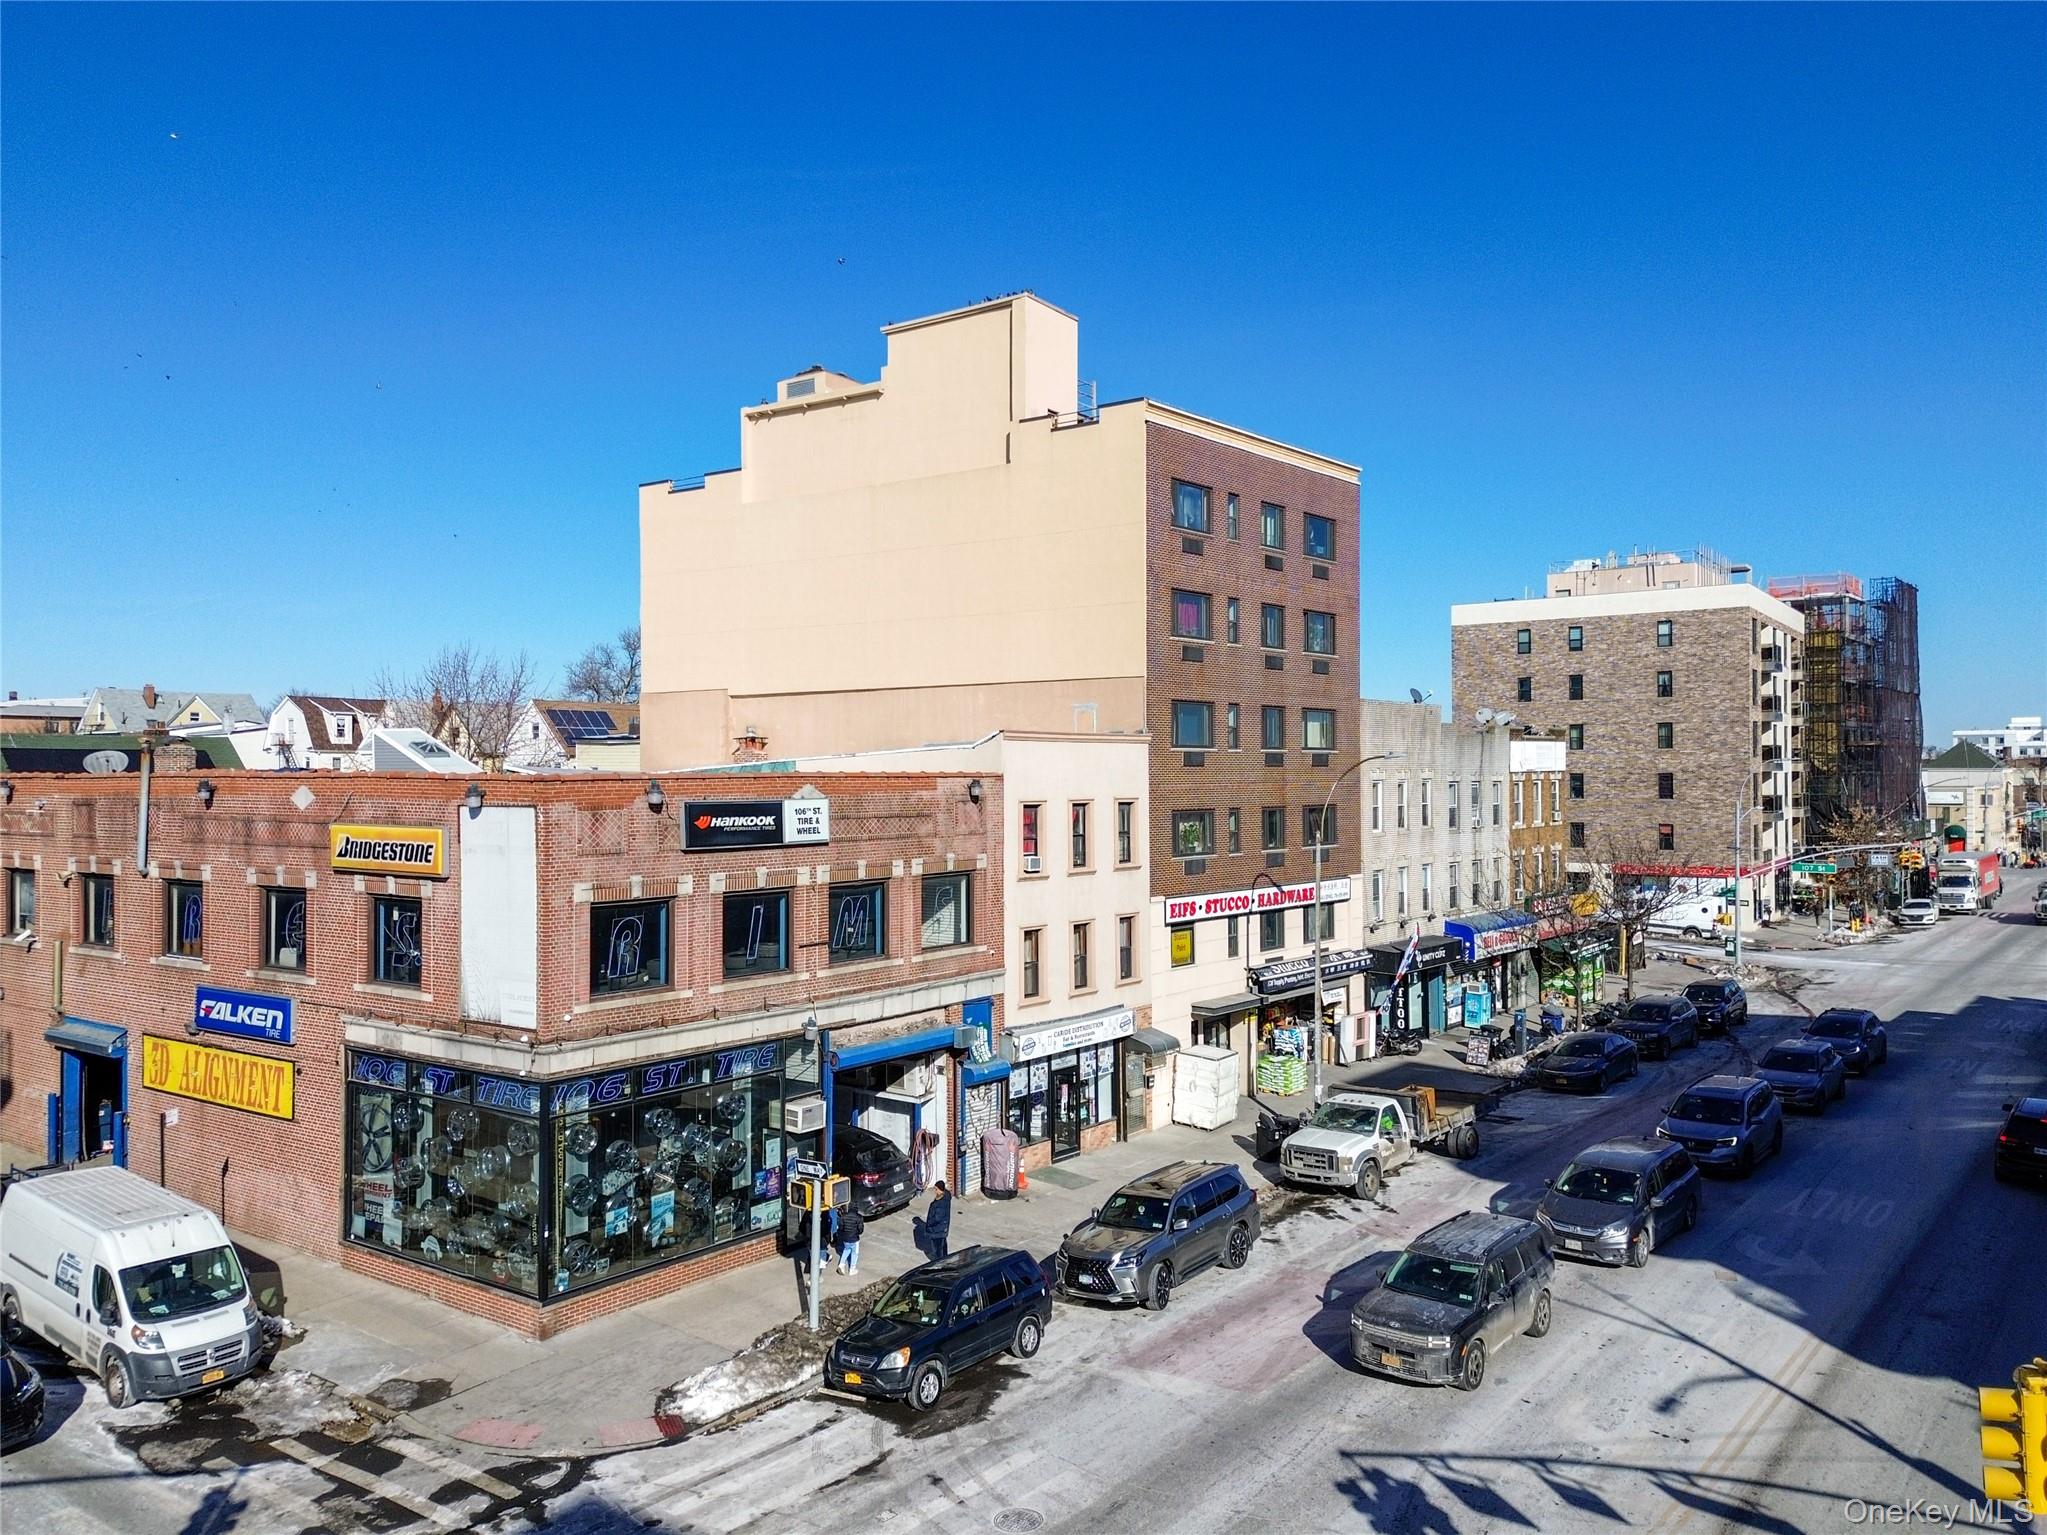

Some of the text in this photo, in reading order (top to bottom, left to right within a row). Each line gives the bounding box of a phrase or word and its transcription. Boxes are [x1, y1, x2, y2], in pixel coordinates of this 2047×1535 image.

[812, 807, 823, 815] ST.
[796, 826, 821, 835] WHEEL
[797, 817, 813, 825] TIRE
[336, 836, 434, 863] BRIDGESTONE
[1169, 901, 1197, 919] EIFS
[1205, 895, 1250, 915] STUCCO
[1257, 887, 1315, 908] HARDWARE
[199, 999, 284, 1030] FALKEN
[265, 1028, 281, 1039] TIRE
[149, 1041, 285, 1113] 3D ALIGNMENT
[550, 1072, 626, 1112] 106
[714, 1043, 776, 1079] TIRE
[478, 1078, 540, 1114] TIRE
[799, 1164, 810, 1172] ONE
[364, 1181, 392, 1191] HEEL
